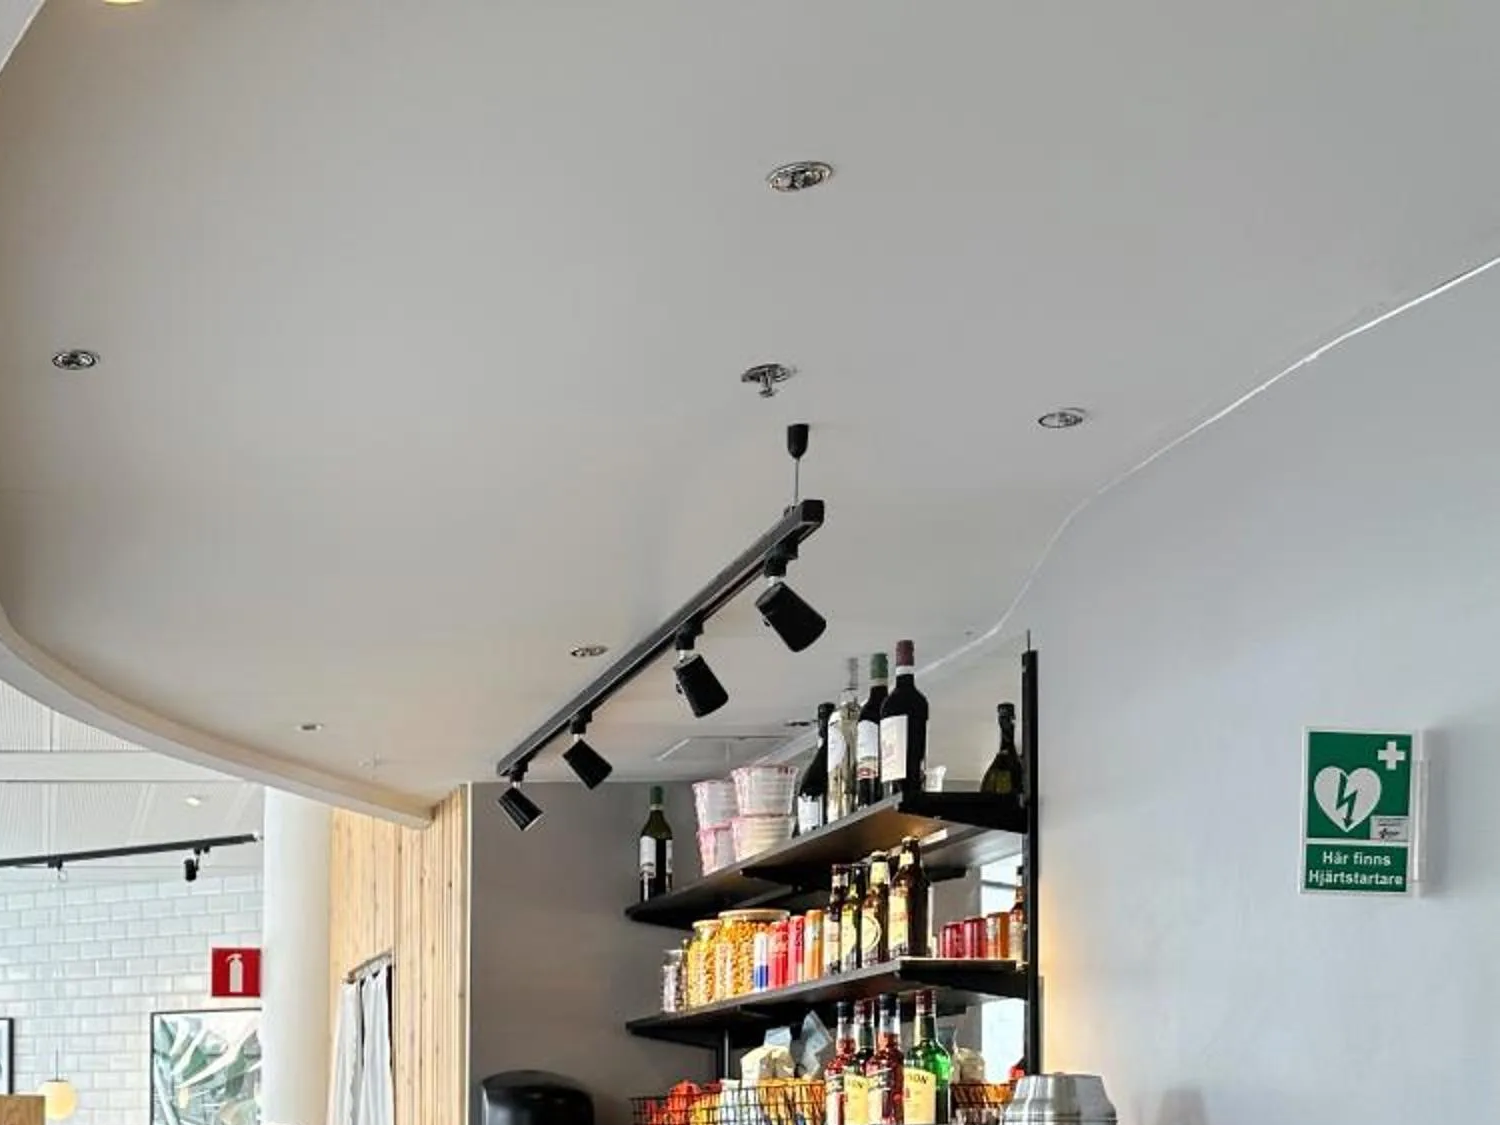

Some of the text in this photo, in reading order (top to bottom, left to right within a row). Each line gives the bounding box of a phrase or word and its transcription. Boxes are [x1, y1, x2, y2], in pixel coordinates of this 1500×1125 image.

[1322, 850, 1392, 867] Här finns
[1308, 869, 1404, 887] Hjärtstartare
